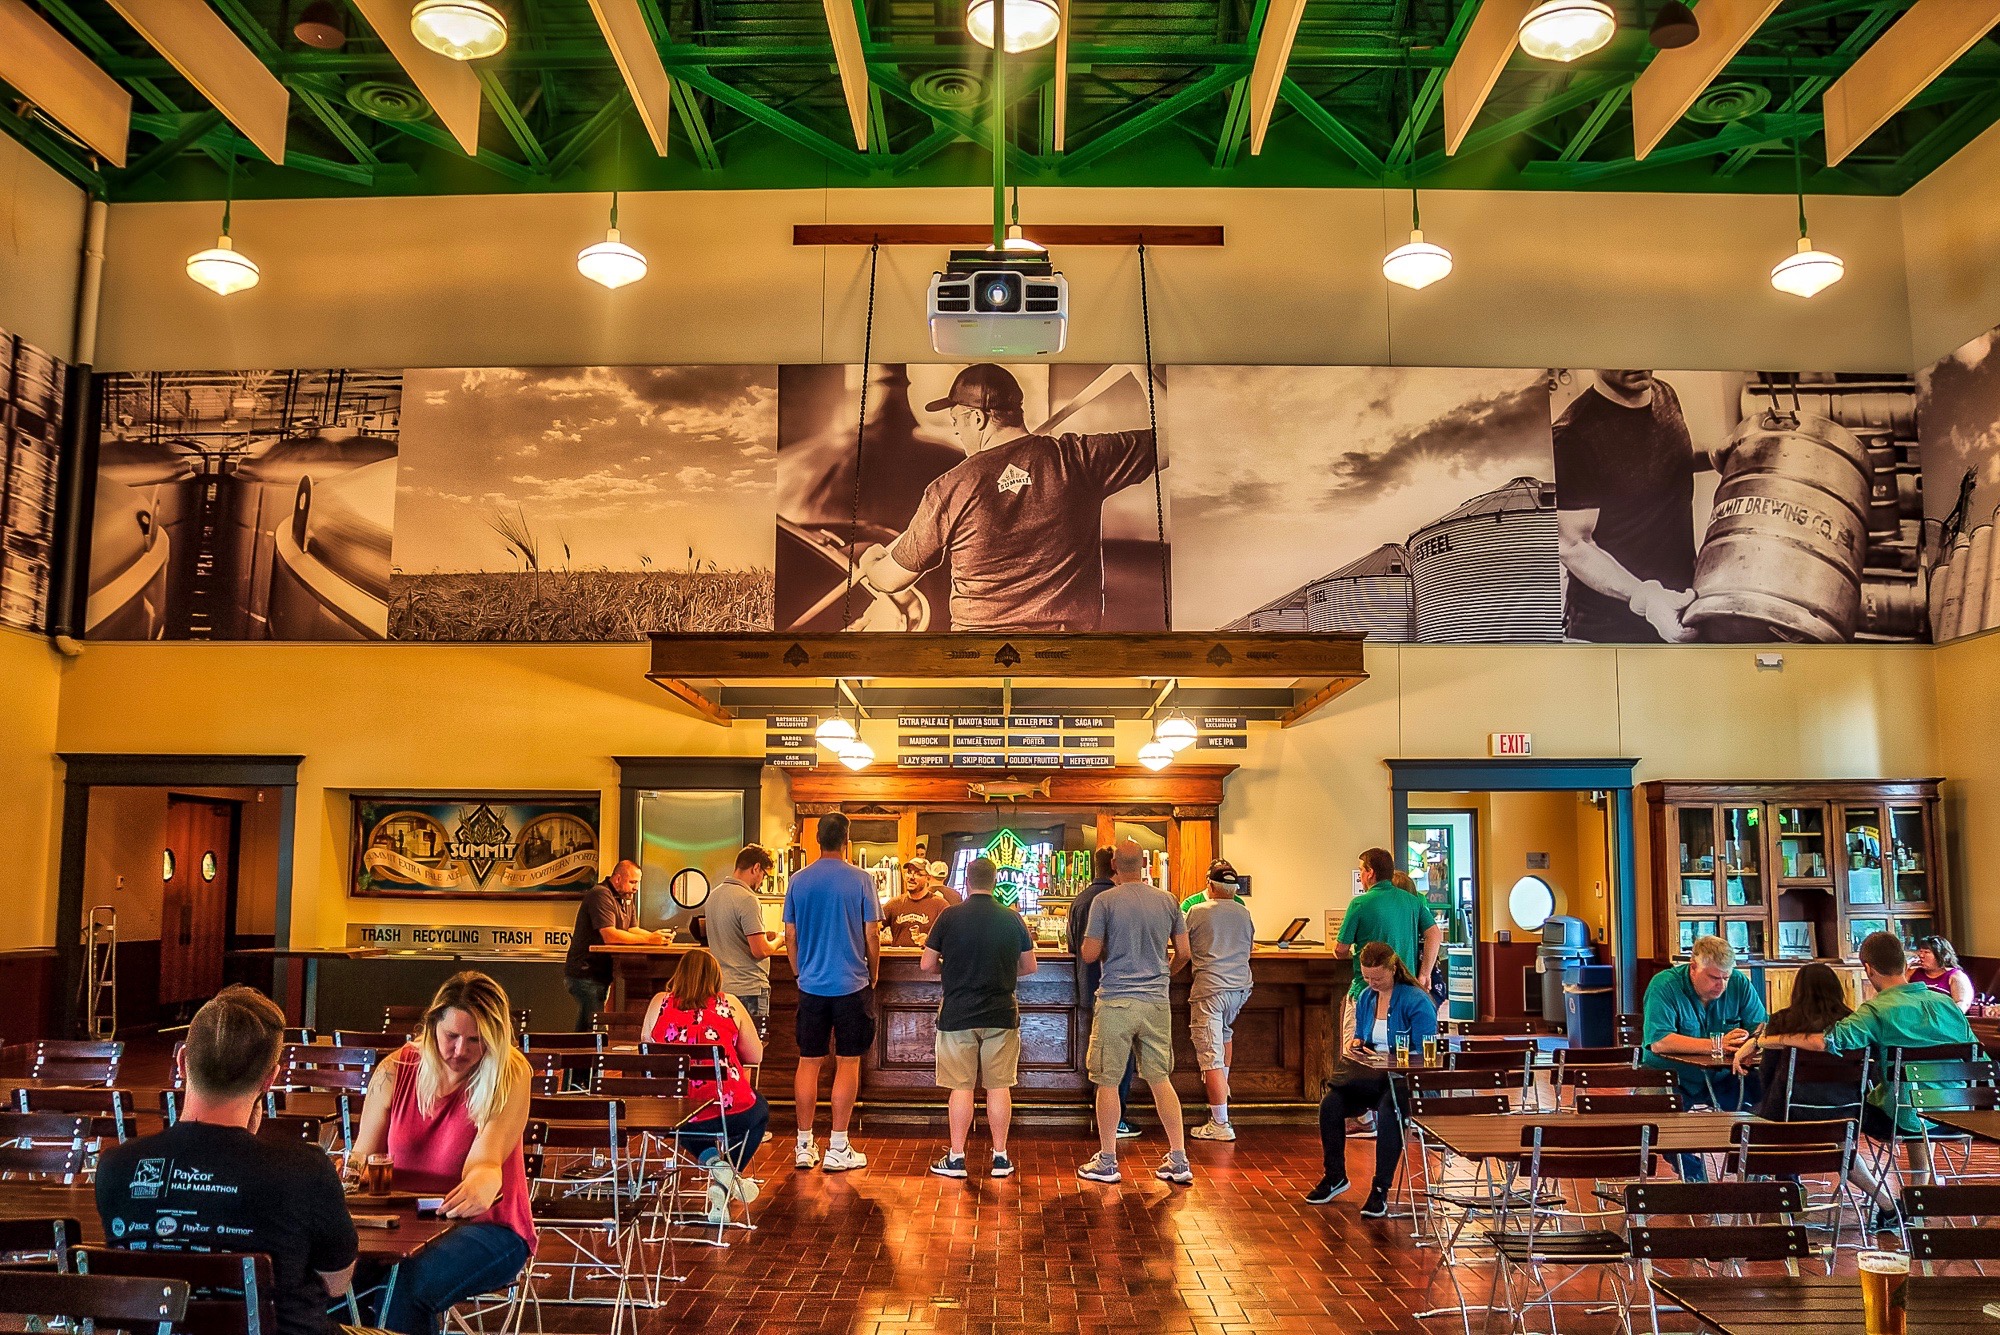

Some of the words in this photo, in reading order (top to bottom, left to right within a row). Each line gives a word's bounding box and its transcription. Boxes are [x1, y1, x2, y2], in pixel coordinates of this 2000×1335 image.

[1416, 534, 1453, 562] STEEL
[899, 718, 920, 726] EXTRA
[920, 718, 936, 726] PALE
[936, 718, 949, 726] ALE
[957, 718, 983, 726] DAKOTA
[983, 718, 1000, 726] SOUL
[1014, 718, 1037, 726] KELLER
[1038, 718, 1053, 726] PILS
[1092, 718, 1103, 726] IPA
[909, 737, 939, 745] MAIBOCK
[1208, 738, 1222, 746] WEE
[1223, 738, 1234, 746] IPA
[1500, 734, 1525, 754] EXIT
[903, 756, 920, 764] LAZY
[920, 756, 944, 765] SIPPER
[962, 756, 978, 764] SKIP
[978, 756, 996, 764] ROCK
[1069, 757, 1109, 765] HEFEWEIZEN
[450, 843, 517, 858] SUMMIT
[398, 858, 422, 876] EXTRA
[424, 871, 442, 882] PALE
[529, 857, 571, 880] NORTHERN
[361, 929, 401, 942] TRASH
[412, 930, 479, 944] RECYCLING
[491, 931, 533, 945] TRASH
[173, 1168, 214, 1182] Paycor
[171, 1182, 192, 1191] HALF
[192, 1183, 239, 1194] MARATHON
[182, 1223, 210, 1233] Paycor
